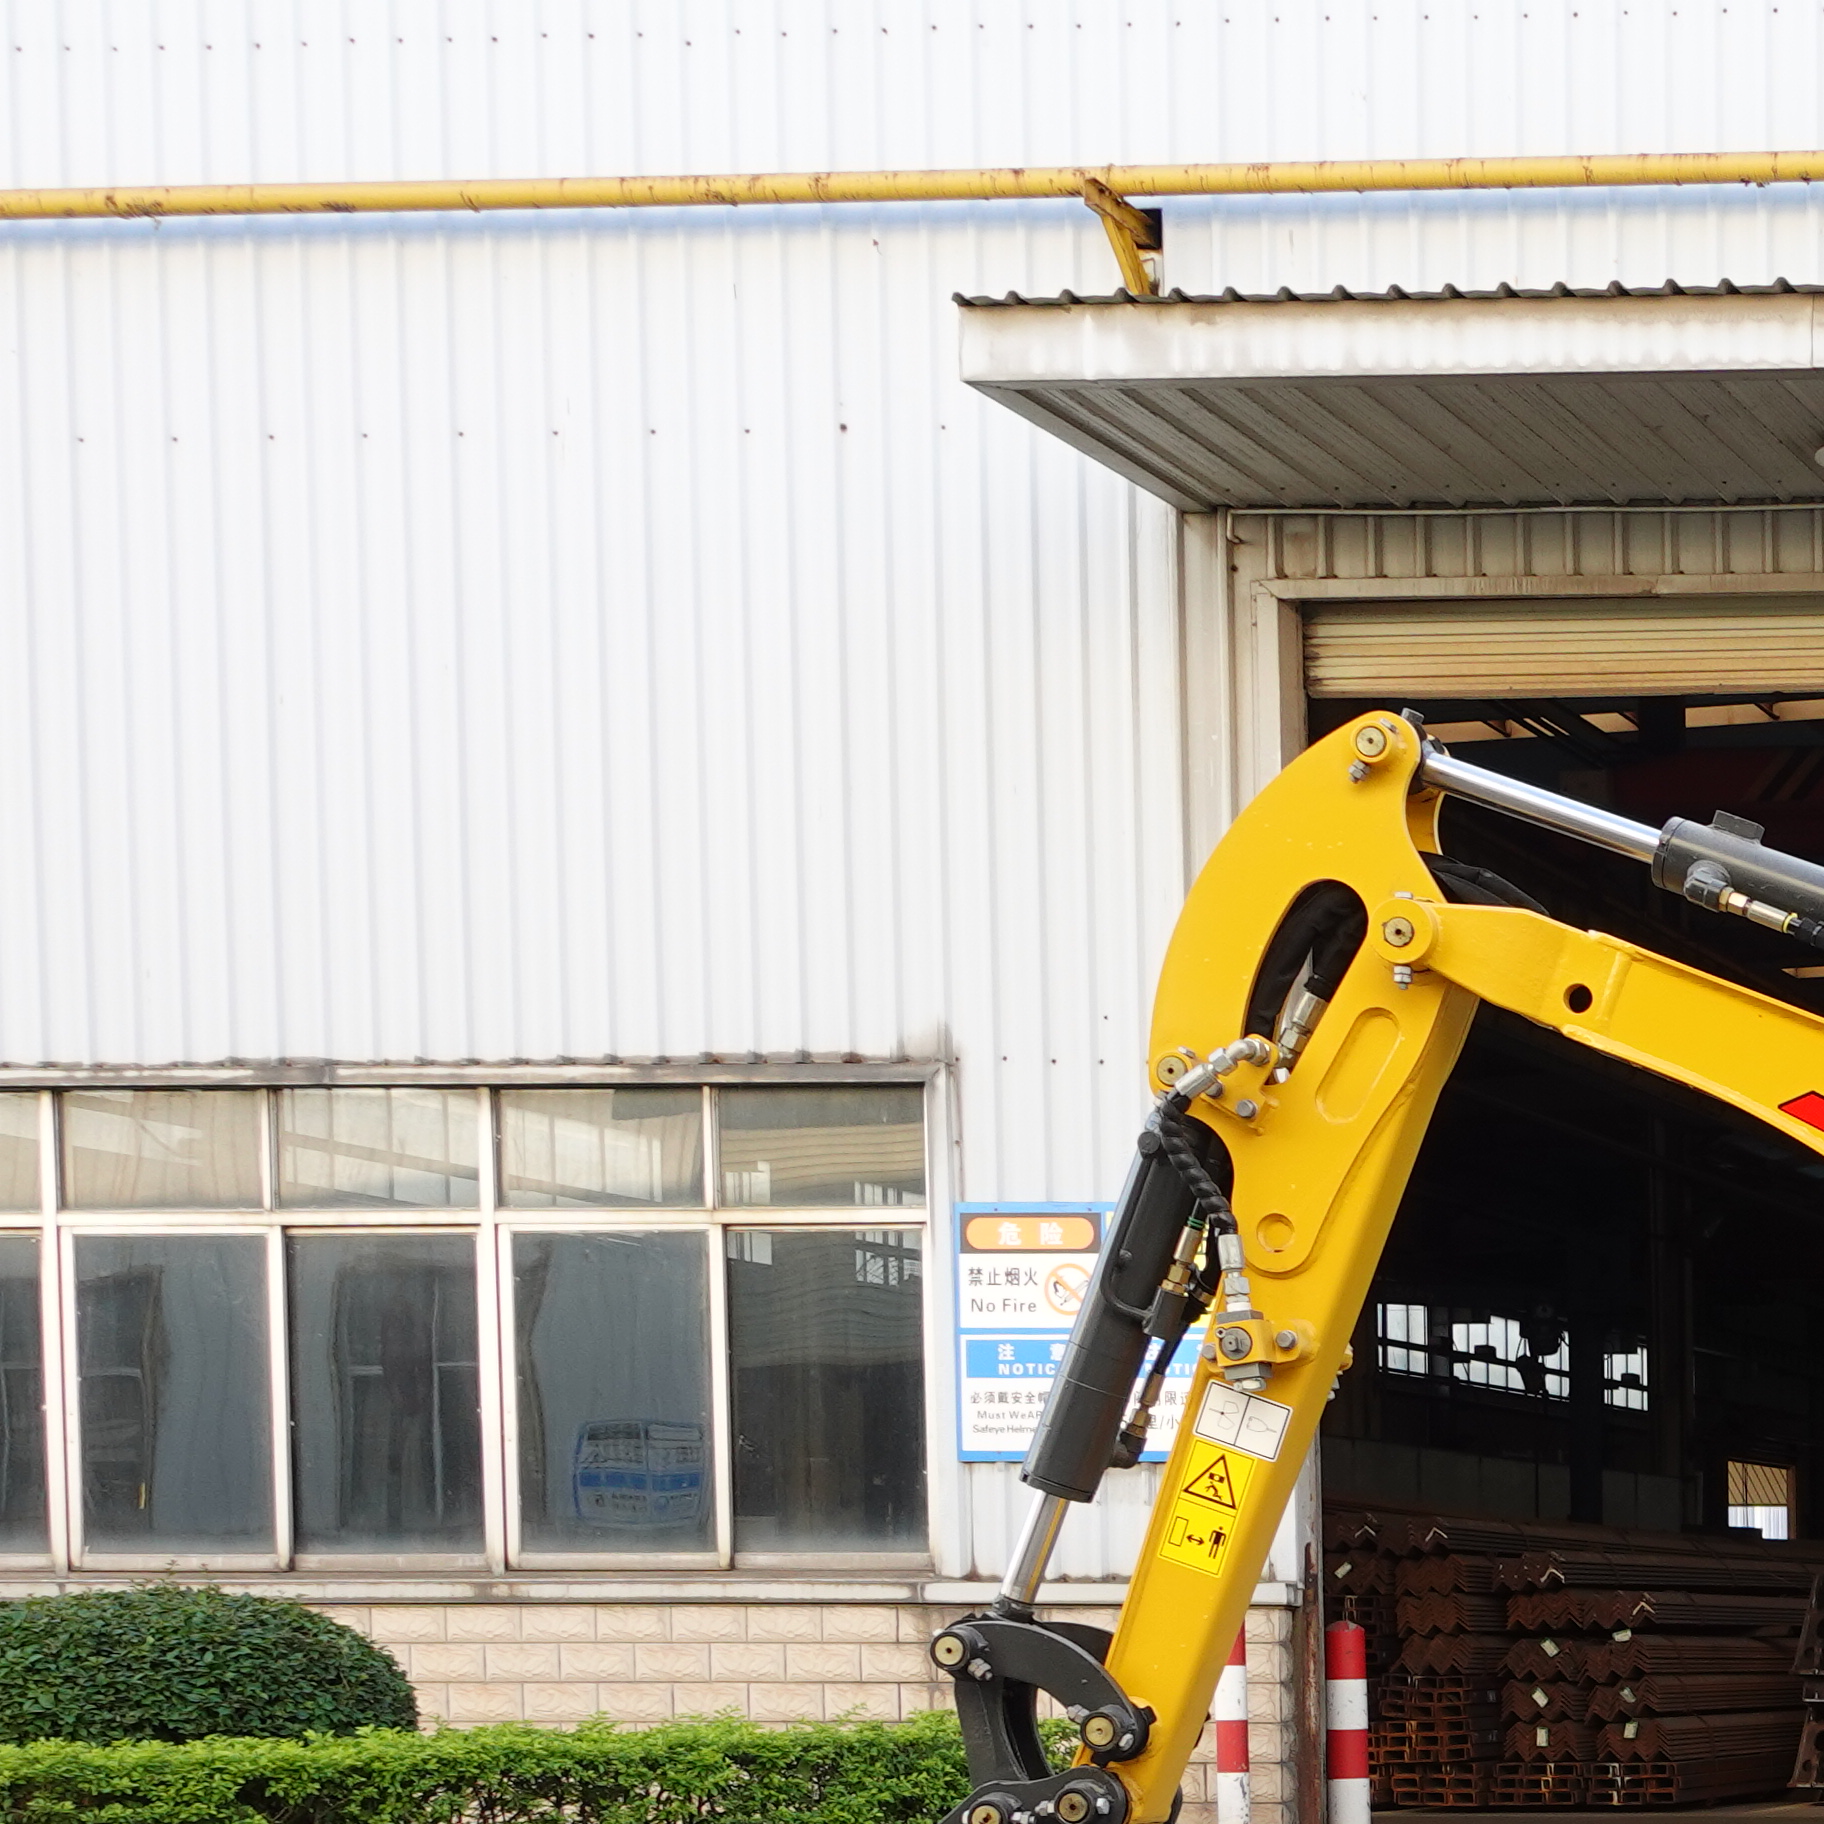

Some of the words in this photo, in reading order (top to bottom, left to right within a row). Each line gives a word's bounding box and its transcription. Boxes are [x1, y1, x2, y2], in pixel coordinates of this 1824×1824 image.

[997, 1221, 1064, 1246] 危险
[967, 1267, 1038, 1287] 禁止烟火
[970, 1298, 996, 1313] No
[1002, 1297, 1037, 1313] Fire
[998, 1362, 1055, 1376] NOTIC
[977, 1410, 1006, 1420] Must
[1007, 1425, 1037, 1434] Helme
